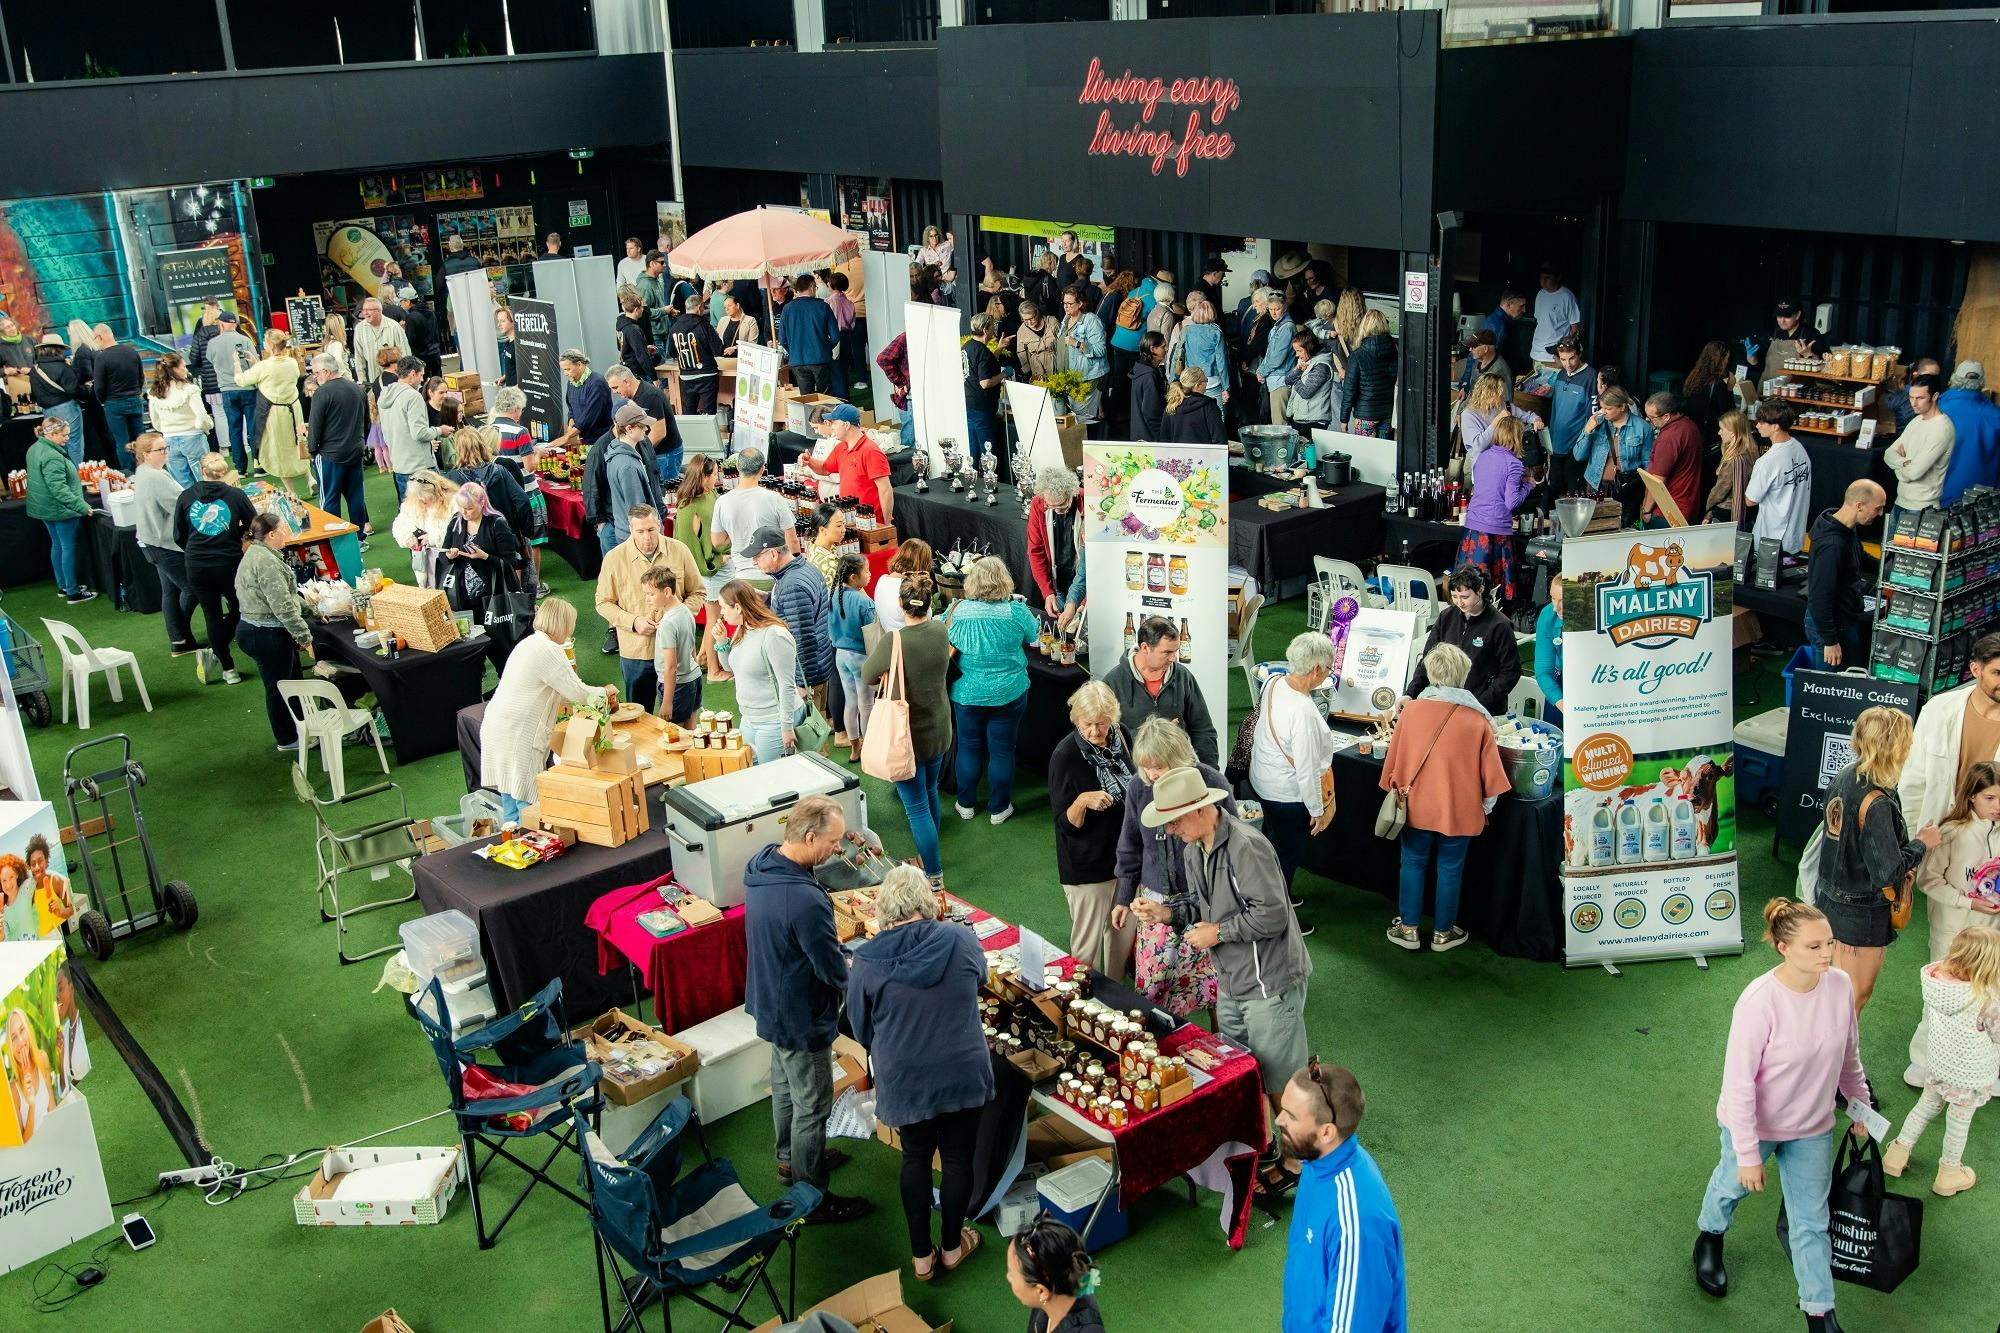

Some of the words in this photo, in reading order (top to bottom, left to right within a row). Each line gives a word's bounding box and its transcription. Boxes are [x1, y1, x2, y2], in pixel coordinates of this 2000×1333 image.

[1079, 57, 1164, 123] living
[1170, 76, 1240, 125] easy,
[1088, 109, 1175, 176] living
[1174, 110, 1235, 177] free
[571, 217, 590, 226] EXIT
[514, 313, 550, 334] TERELLA
[1131, 489, 1180, 506] Fermentier
[1609, 587, 1698, 616] MALENY
[1618, 617, 1692, 640] DAIRIES
[1591, 663, 1619, 683] It's
[1623, 661, 1650, 680] all
[1638, 651, 1713, 694] good!
[1599, 703, 1622, 711] Dairies
[1639, 697, 1688, 707] award-winning,
[1688, 690, 1728, 700] family-owned
[1802, 682, 1864, 700] Montville
[1867, 691, 1909, 706] Coffee
[1583, 719, 1627, 728] sustainability
[1638, 716, 1662, 724] people,
[1693, 708, 1722, 718] products.
[1609, 710, 1639, 718] operated
[1640, 707, 1668, 715] business
[1668, 703, 1703, 711] committed
[1584, 743, 1617, 760] MULTI
[1581, 752, 1624, 772] Award
[1582, 764, 1628, 783] WINNING
[1613, 880, 1648, 888] NATURALLY
[1663, 876, 1691, 884] BOTTLED
[1705, 870, 1735, 880] DELIVERED
[1572, 893, 1602, 901] SOURCED
[1573, 884, 1600, 892] LOCALLY
[1614, 889, 1648, 897] PRODUCED
[1669, 885, 1686, 893] COLD
[1598, 929, 1710, 946] www.malenydairies.com
[0, 1177, 72, 1219] unshine
[1831, 1219, 1877, 1242] unshine
